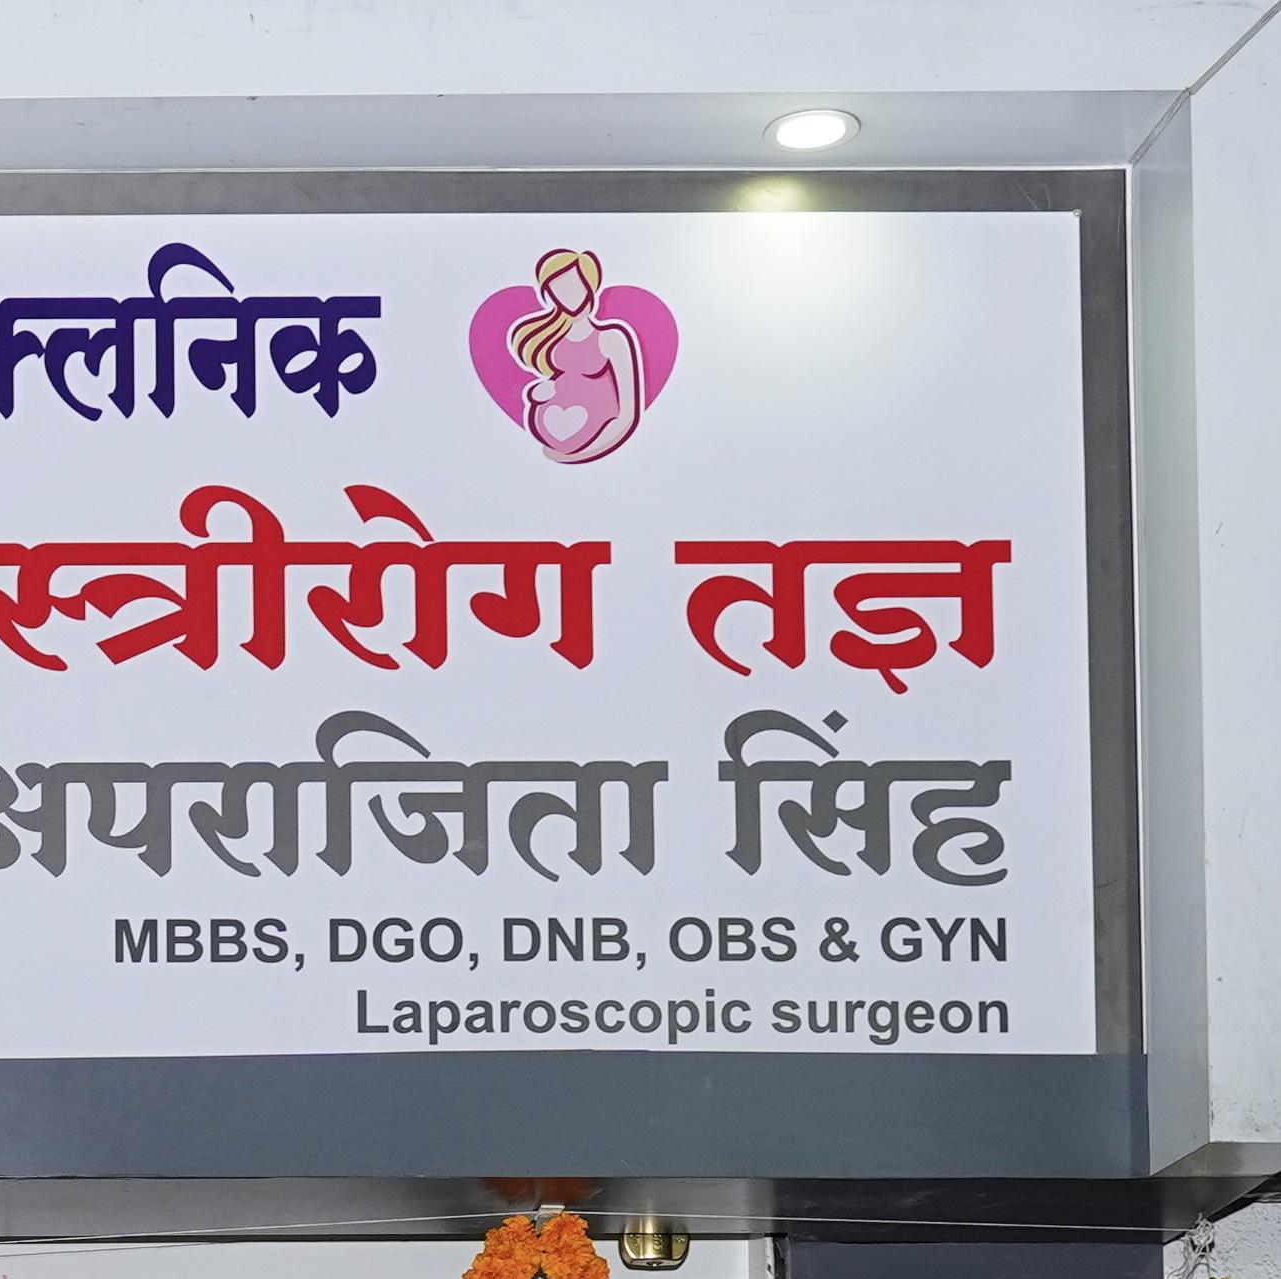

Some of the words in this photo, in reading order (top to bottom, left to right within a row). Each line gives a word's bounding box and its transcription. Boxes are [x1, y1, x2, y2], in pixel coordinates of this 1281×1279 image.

[674, 540, 1012, 694] तज्ञ
[718, 710, 1012, 886] सिंह
[115, 918, 304, 972] MBBS,
[330, 917, 478, 971] DGO,
[504, 918, 646, 970] DNB,
[669, 917, 797, 962] OBS
[819, 917, 860, 962] &
[881, 917, 1007, 962] GYN
[357, 989, 751, 1045] Laparoscopic
[772, 1000, 1008, 1045] surgeon
